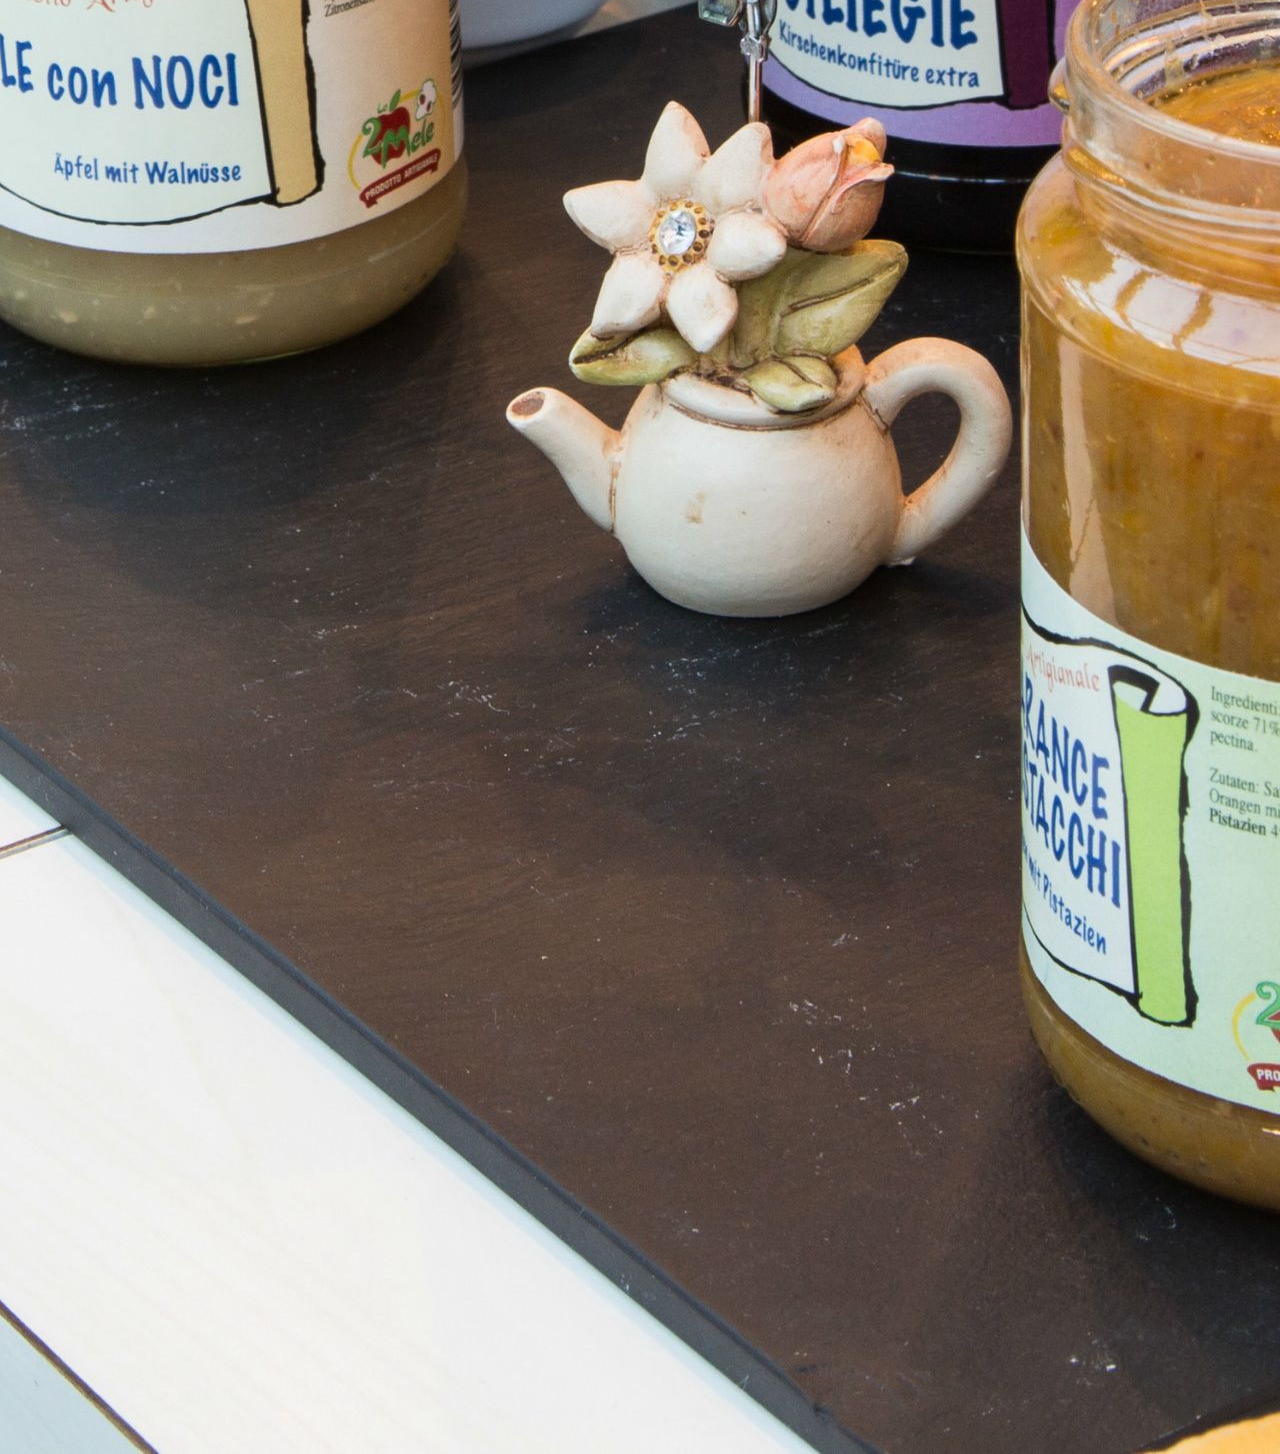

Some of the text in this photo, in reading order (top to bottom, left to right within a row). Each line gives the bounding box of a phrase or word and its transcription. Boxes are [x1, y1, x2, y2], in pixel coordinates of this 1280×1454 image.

[779, 19, 979, 88] Kirschenkonfitüre extra
[47, 63, 117, 108] con
[131, 53, 239, 110] NOCI
[54, 152, 241, 184] Äpfel mit Walnüsse
[1211, 686, 1280, 716] Ingredienti:
[1210, 710, 1249, 730] scorze
[1022, 671, 1109, 820] RANCE
[1210, 730, 1258, 752] pectina.
[1209, 767, 1259, 794] Zutaten:
[1209, 788, 1261, 814] Orangen
[1023, 741, 1120, 908] STACCHI
[1209, 808, 1266, 836] Pistazien
[1043, 874, 1106, 954] Pistazien
